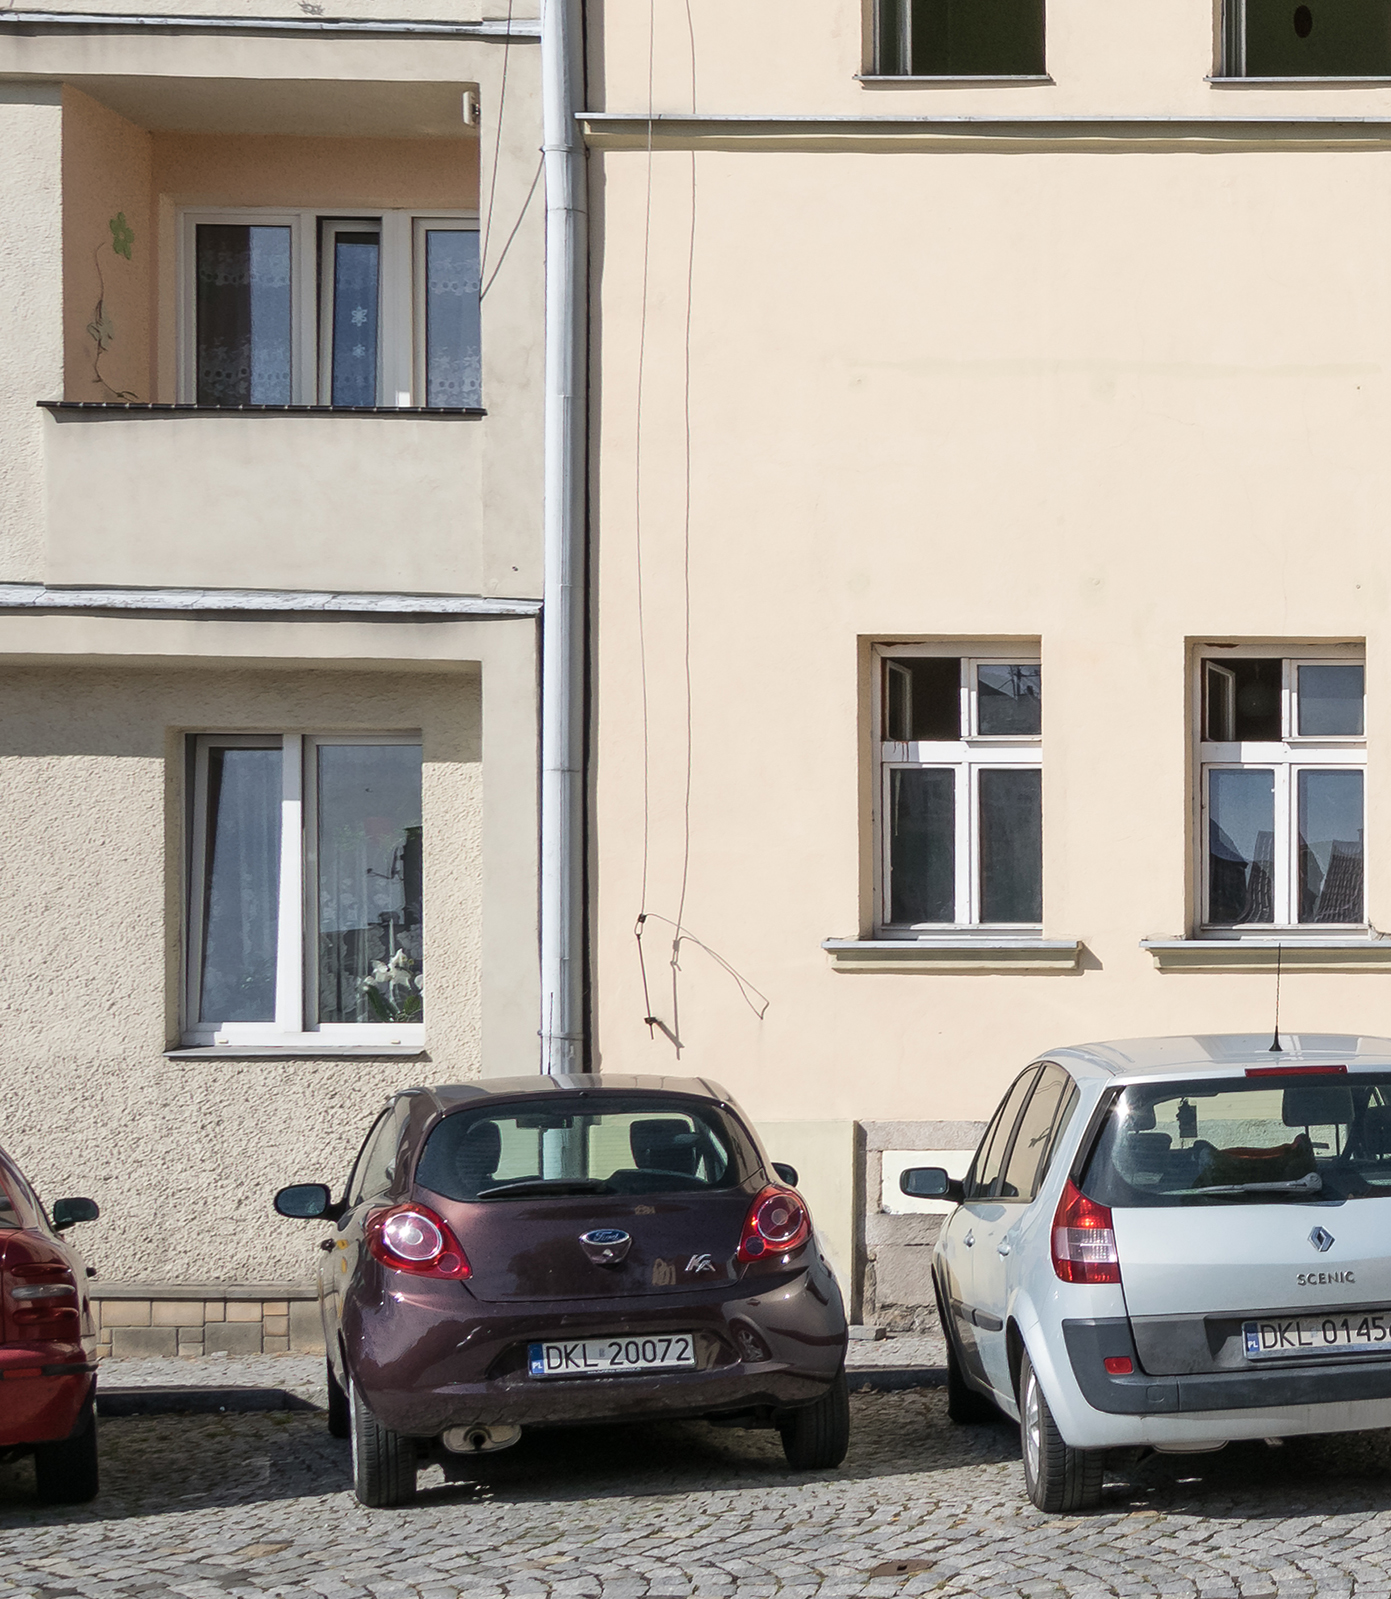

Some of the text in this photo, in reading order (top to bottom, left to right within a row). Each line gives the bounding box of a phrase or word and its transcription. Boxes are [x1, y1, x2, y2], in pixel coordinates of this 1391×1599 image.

[592, 1231, 620, 1242] Ford
[1296, 1271, 1356, 1287] SCENIC
[1247, 1341, 1259, 1349] PL
[1260, 1321, 1313, 1349] DKL
[532, 1337, 691, 1371] PL DKL 20072
